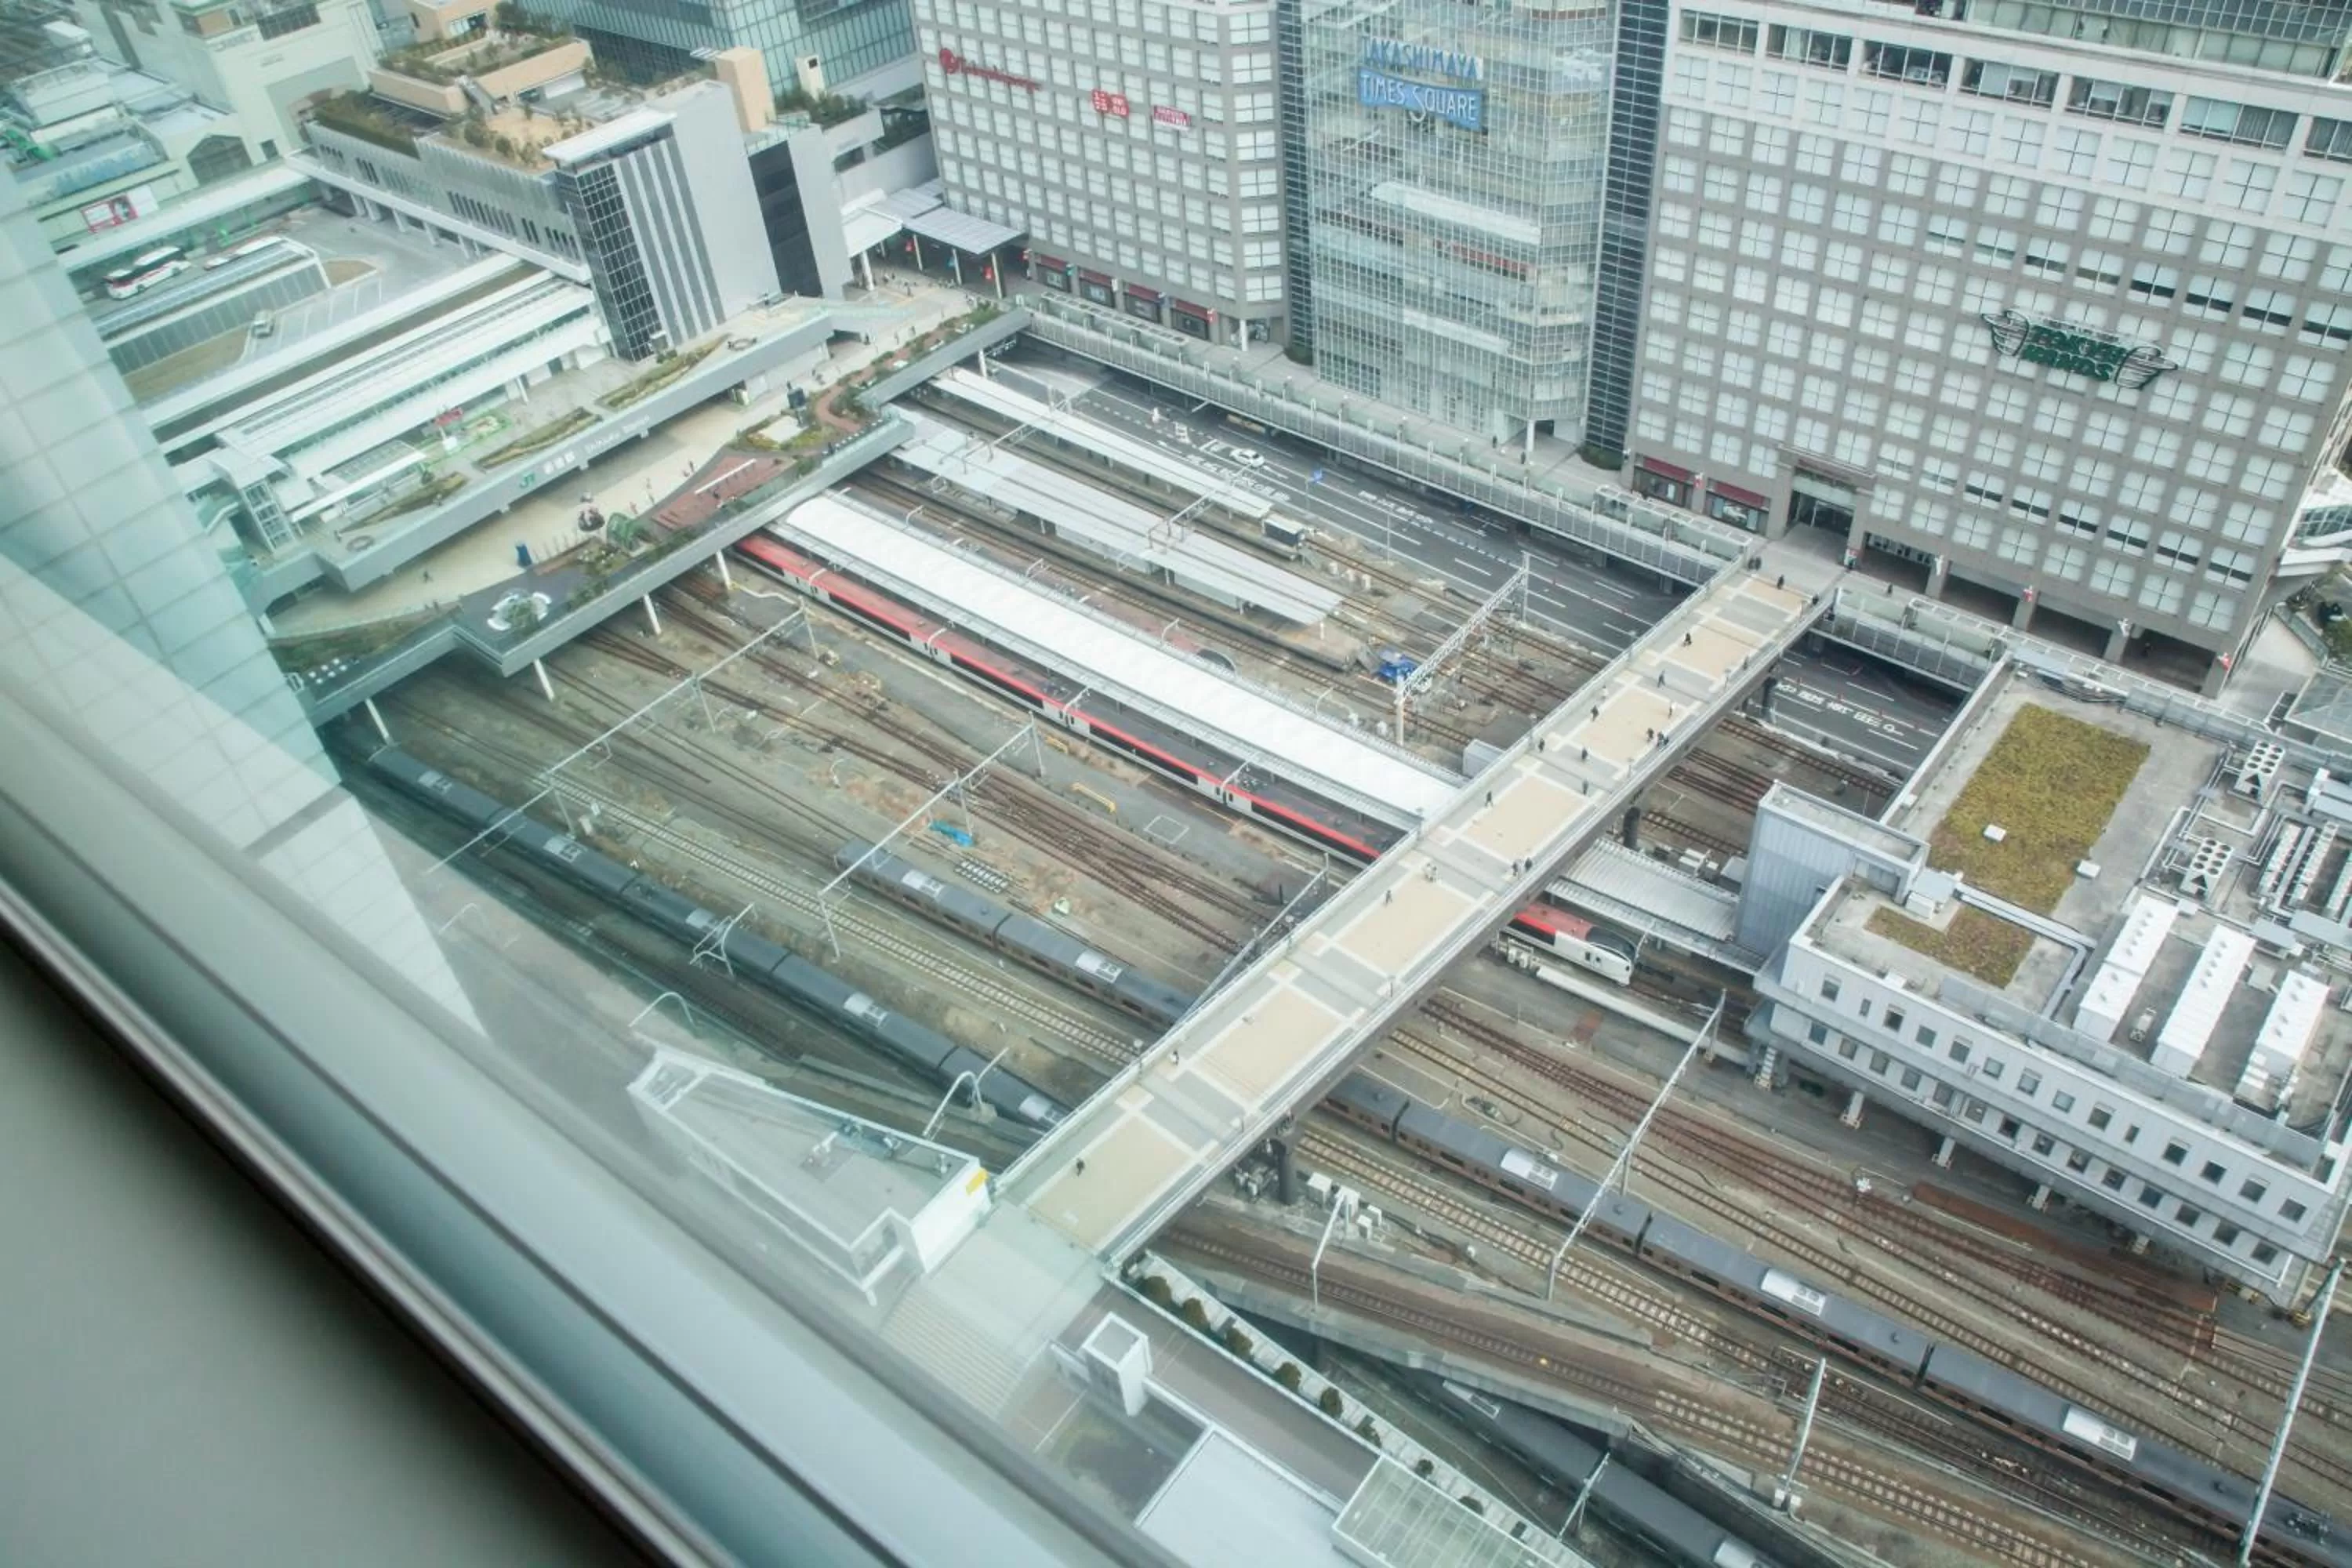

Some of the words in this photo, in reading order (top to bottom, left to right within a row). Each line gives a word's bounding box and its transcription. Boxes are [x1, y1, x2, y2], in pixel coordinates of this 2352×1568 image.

[1363, 36, 1479, 79] TAKASHIMAYA
[1360, 74, 1406, 105] TIMES
[1410, 85, 1477, 122] SQUARE
